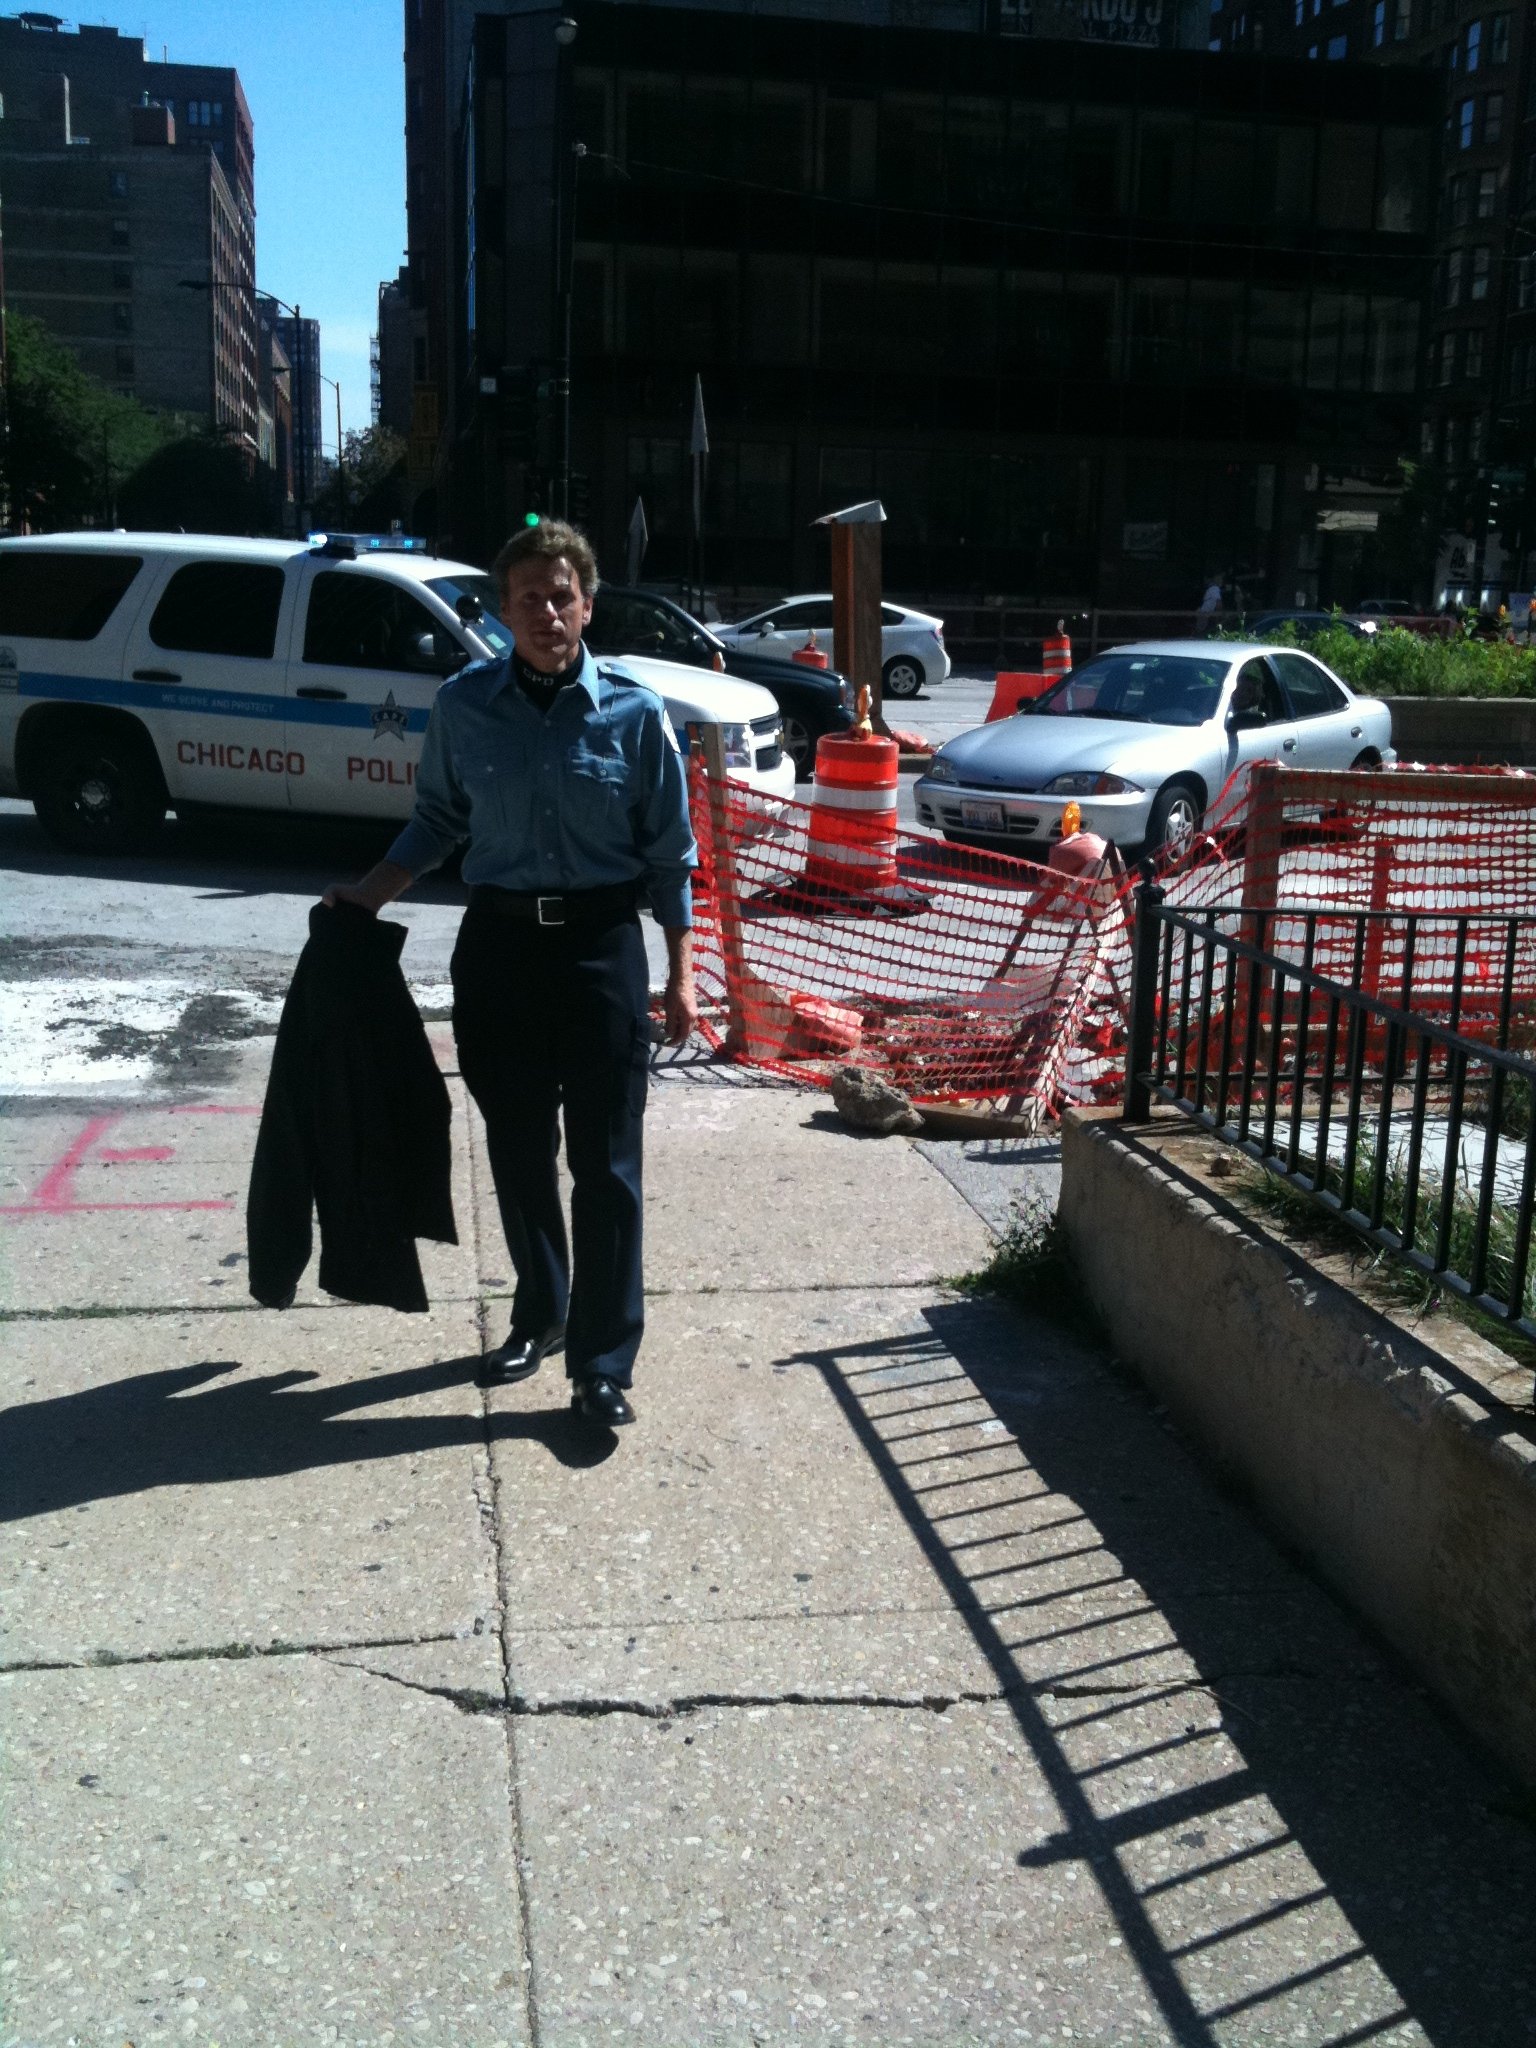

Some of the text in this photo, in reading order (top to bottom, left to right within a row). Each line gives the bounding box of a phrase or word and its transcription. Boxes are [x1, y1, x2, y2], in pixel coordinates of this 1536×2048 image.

[211, 699, 231, 709] AND
[232, 700, 276, 713] PROTECT
[177, 740, 419, 785] CHICAGO POLI
